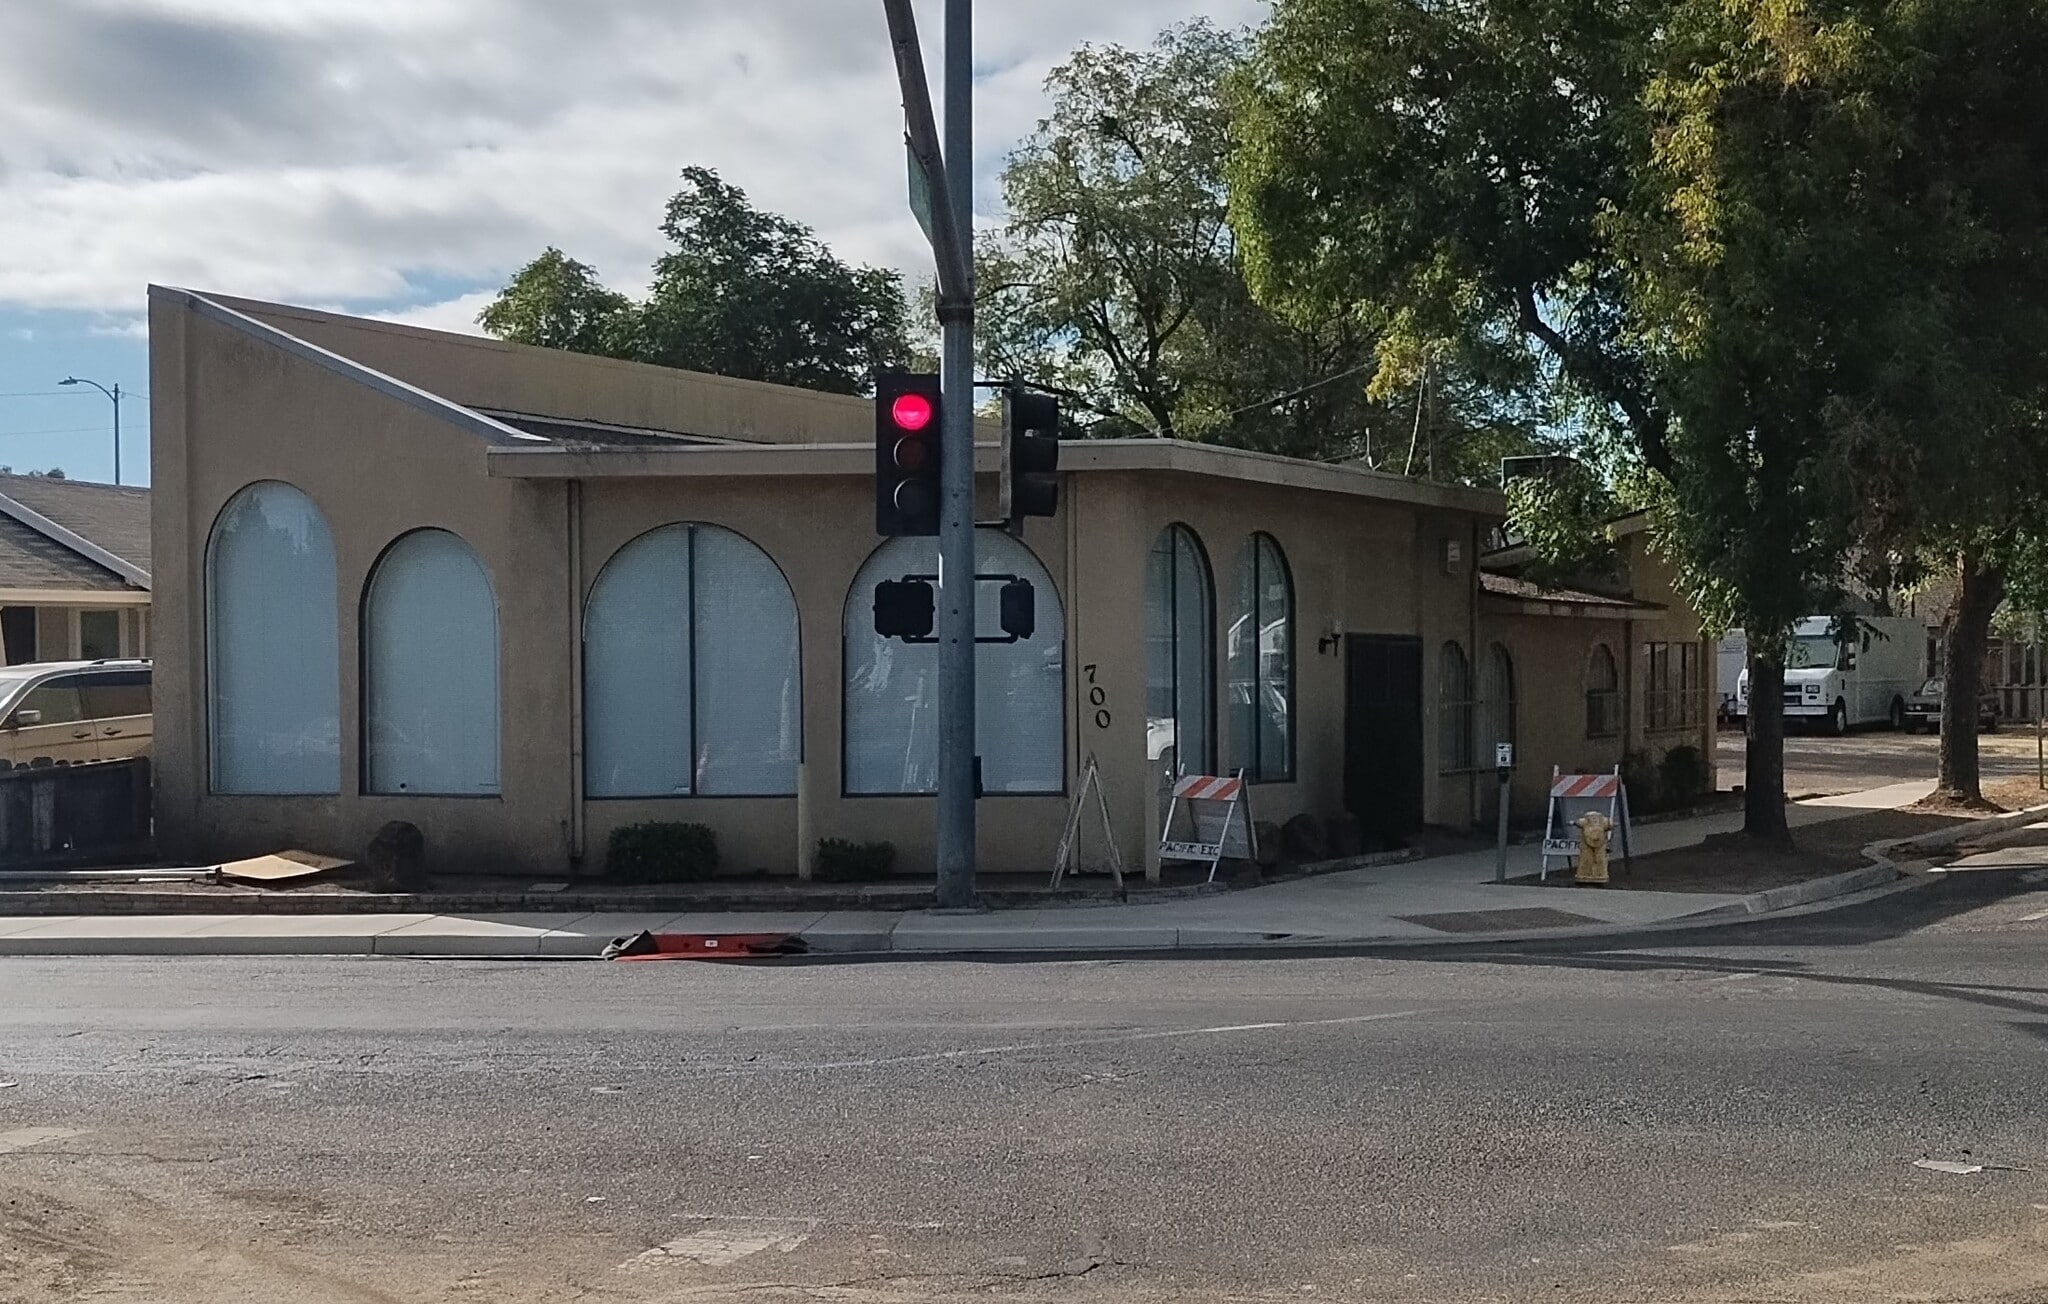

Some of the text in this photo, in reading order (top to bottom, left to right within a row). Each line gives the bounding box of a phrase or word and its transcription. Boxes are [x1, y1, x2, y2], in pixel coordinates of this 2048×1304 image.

[1084, 664, 1112, 729] 700
[1159, 842, 1197, 854] PACIFIC
[1544, 840, 1580, 850] PACIFI
